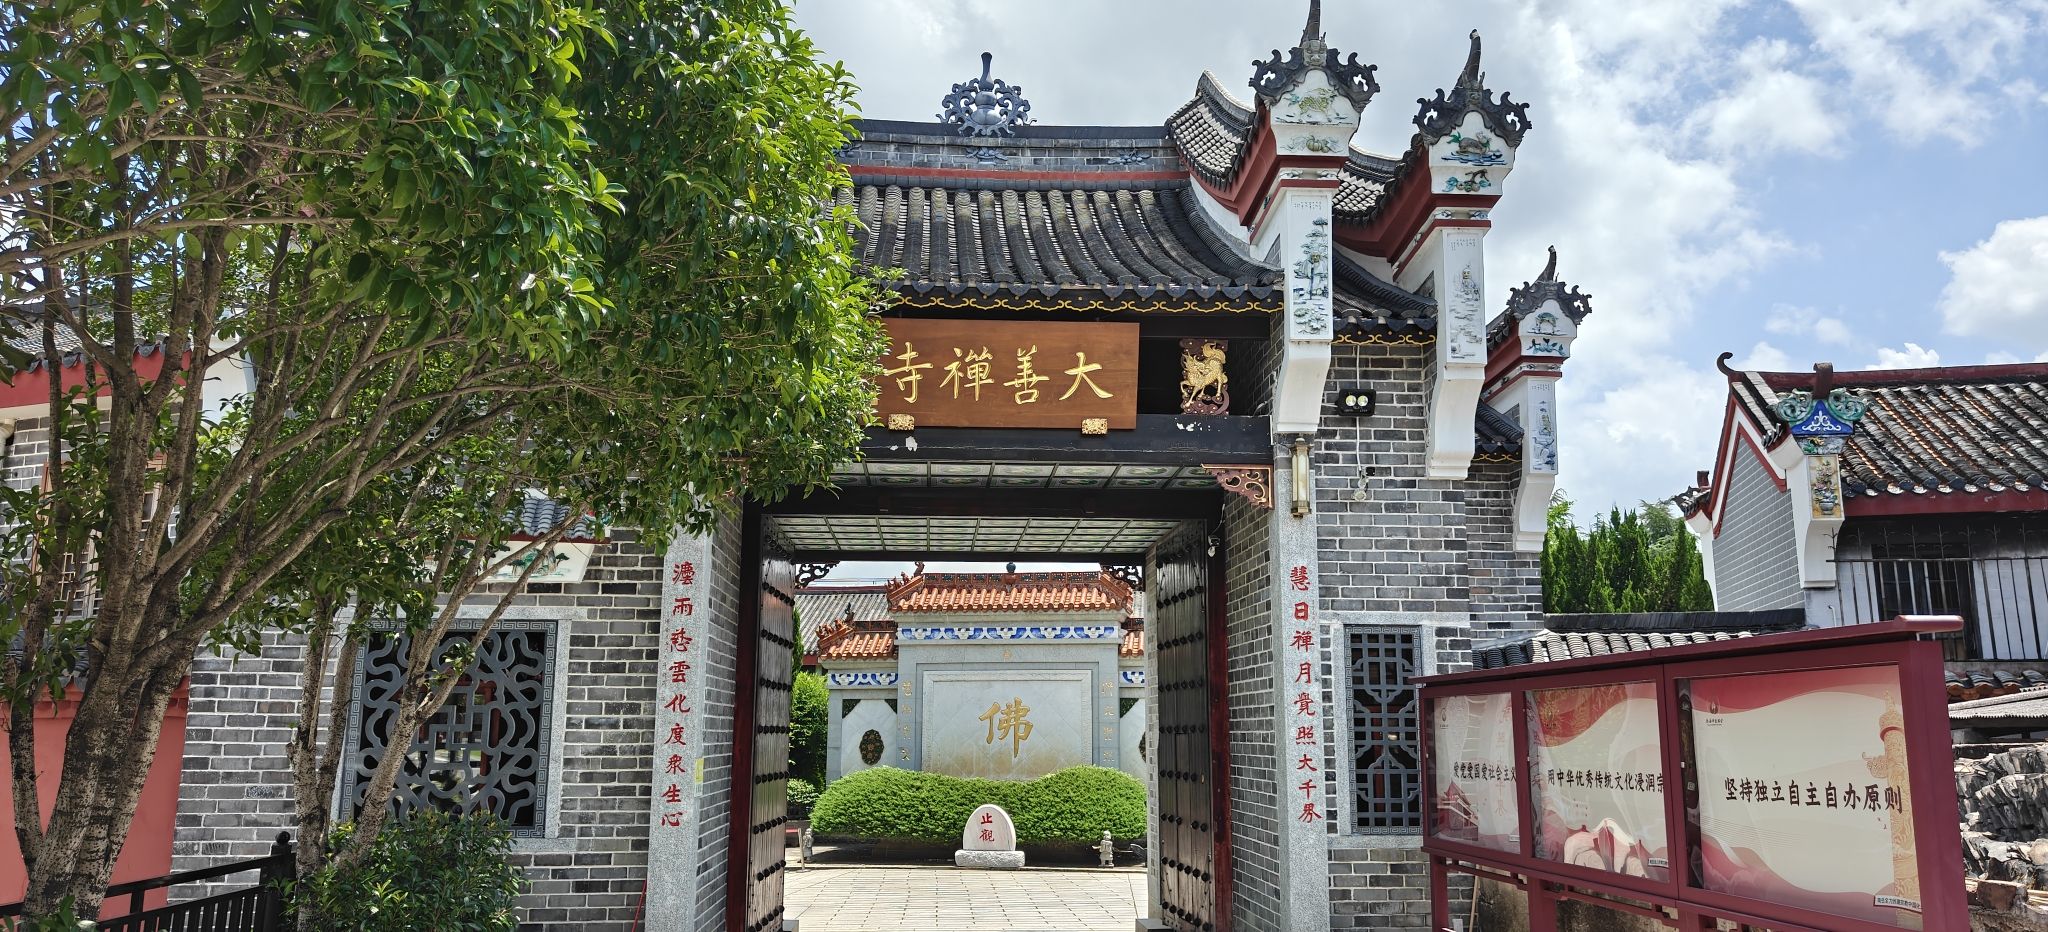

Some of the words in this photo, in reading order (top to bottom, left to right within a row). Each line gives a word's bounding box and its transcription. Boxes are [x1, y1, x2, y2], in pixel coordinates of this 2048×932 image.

[884, 341, 1114, 404] 大善禪寺
[978, 696, 1034, 758] 佛
[1724, 777, 1903, 814] 坚持独立自主自办原则
[979, 812, 995, 842] 止觀
